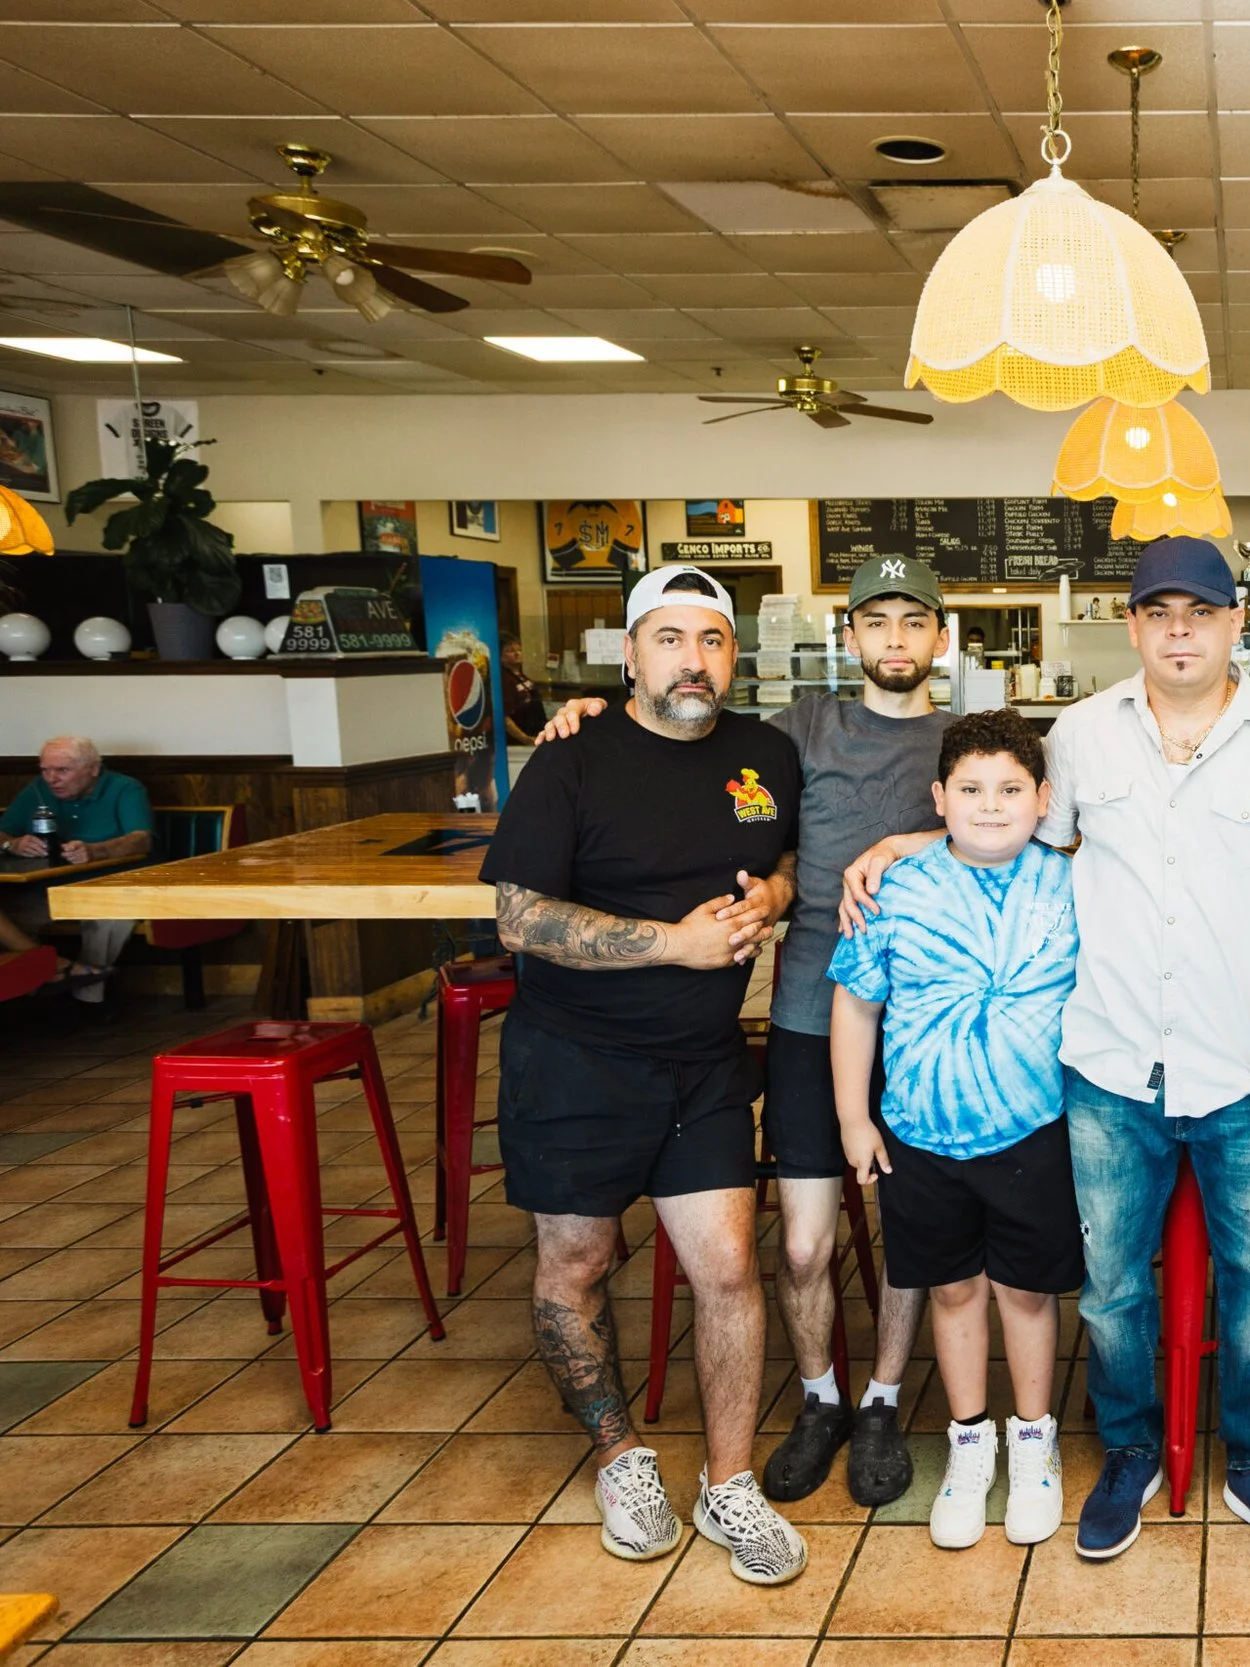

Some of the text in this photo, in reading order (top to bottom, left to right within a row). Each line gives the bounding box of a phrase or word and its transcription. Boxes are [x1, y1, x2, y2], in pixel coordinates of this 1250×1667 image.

[677, 543, 709, 554] GENCO
[711, 542, 756, 554] IMPORTS
[1008, 554, 1060, 567] FRESH BREAD
[880, 559, 906, 579] NY
[366, 600, 398, 620] AVE
[292, 625, 324, 639] 581
[286, 638, 331, 651] 9999
[339, 632, 412, 649] 581-9999
[454, 731, 487, 756] pepsi
[737, 805, 776, 819] WEST AVE
